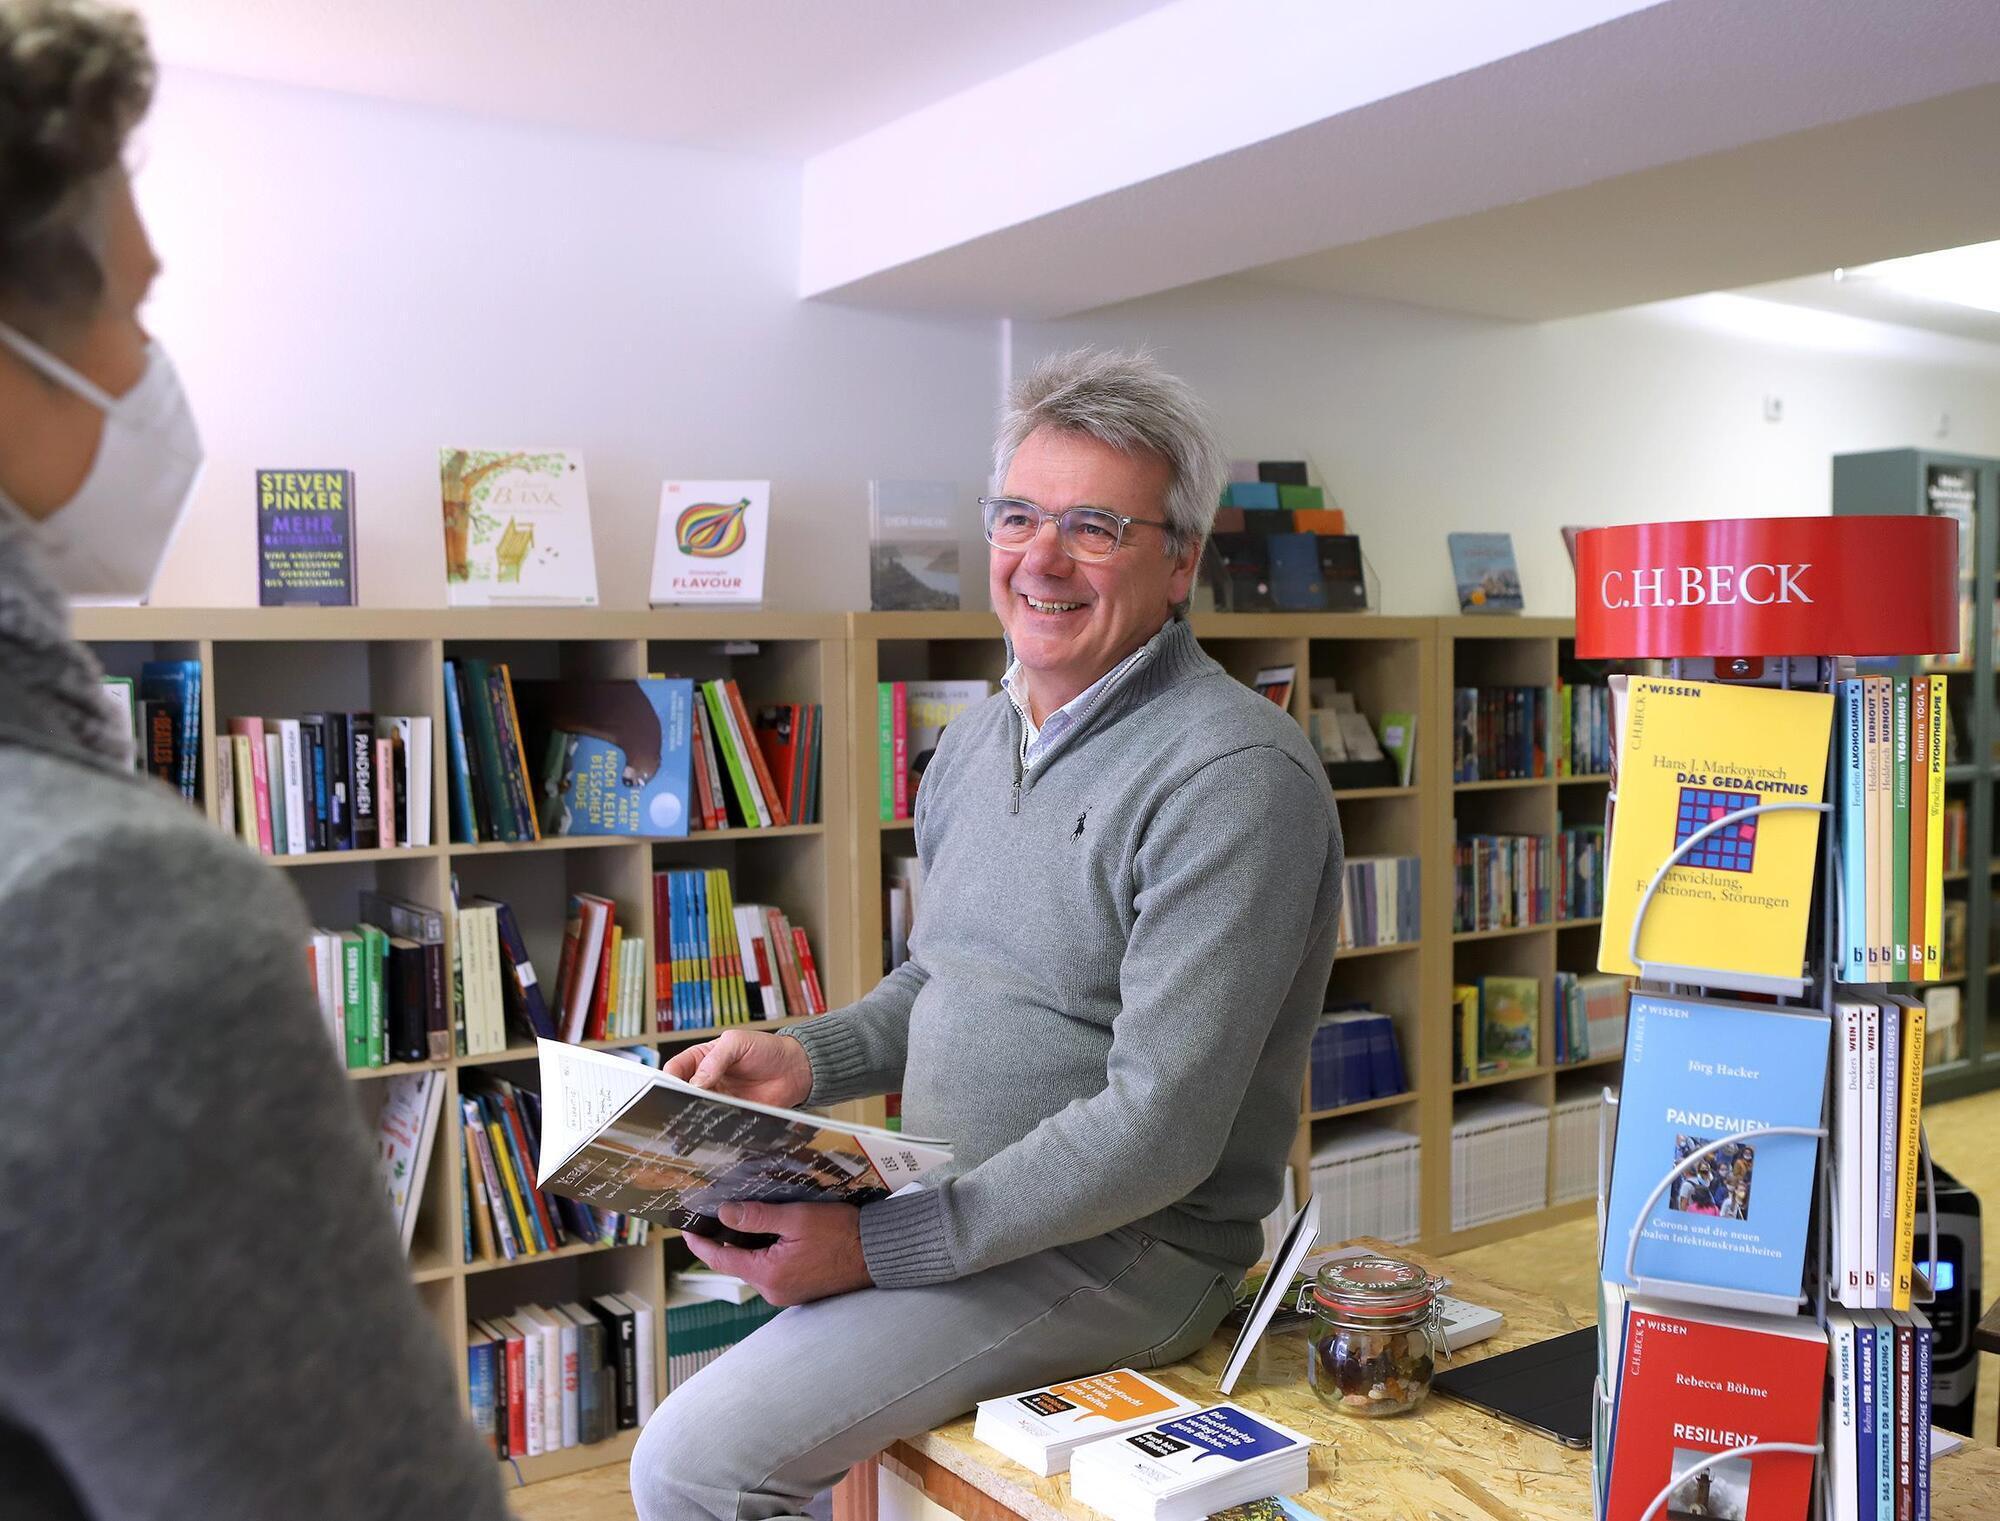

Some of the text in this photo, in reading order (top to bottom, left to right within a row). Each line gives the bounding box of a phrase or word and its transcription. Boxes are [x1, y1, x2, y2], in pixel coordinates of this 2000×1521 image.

[261, 473, 343, 492] STEVEN
[262, 491, 343, 510] PINKER
[272, 516, 333, 533] MEHR
[672, 577, 742, 588] FLAVOUR
[1601, 563, 1815, 609] C.H.BECK
[1650, 684, 1701, 698] WISSEN
[1916, 694, 1926, 720] YOGA
[1631, 697, 1646, 750] C.H.BECK
[1852, 698, 1860, 770] ALKOHOLISMUS
[1933, 696, 1942, 773] PSYCHOTHERAPIE
[1868, 698, 1877, 792] Hedderich BURNOUT
[1882, 696, 1890, 791] Hedderich BURNOUT
[1897, 696, 1906, 808] Leitzmann VEGANISMUS
[355, 733, 371, 815] PANDEMIEN
[1652, 755, 1787, 780] Hans J. Markowitsch
[589, 754, 603, 824] BISSCHEN
[603, 749, 617, 829] NOCH KEIN
[1676, 773, 1809, 795] DAS GEDÄCHTNIS
[1656, 867, 1743, 890] ntwicklung,
[1649, 1005, 1689, 1019] WISSEN
[1633, 1014, 1646, 1063] C.H.BECK
[1688, 1060, 1760, 1080] Jörg Hacker
[1849, 1026, 1857, 1091] Deckers WEIN
[1867, 1025, 1876, 1090] Deckers WEIN
[1911, 1027, 1922, 1104] WELTGESCHICHTE
[1882, 1024, 1896, 1218] Dittmann DER SPRACHERWERB DES KINDES
[1910, 1109, 1919, 1126] DER
[1908, 1128, 1917, 1156] DATEN
[1905, 1158, 1916, 1220] WICHTIGSTEN
[1653, 1217, 1760, 1242] Corona und die neuen
[1904, 1221, 1912, 1237] DIE
[1673, 1233, 1782, 1259] Infektionskrankheiten
[1648, 1320, 1688, 1335] WISSEN
[1631, 1329, 1645, 1376] C.H.BECK
[1841, 1345, 1849, 1381] WISSEN
[1863, 1346, 1872, 1382] KORAN
[1901, 1343, 1909, 1372] REICH
[1104, 1375, 1120, 1384] Der
[1676, 1373, 1768, 1398] Rebecca Böhme
[1881, 1344, 1890, 1408] AUFKLÄRUNG
[1920, 1344, 1929, 1402] REVOLUTION
[1063, 1384, 1086, 1396] gute
[1079, 1381, 1113, 1401] hat viele
[1863, 1383, 1872, 1404] DER
[1899, 1374, 1909, 1424] RÖMISCHE
[1209, 1411, 1228, 1421] Der
[1882, 1411, 1890, 1430] DER
[1134, 1436, 1146, 1444] zu
[1142, 1433, 1179, 1452] Auch hier
[1170, 1423, 1228, 1450] gute Bücher.
[1186, 1418, 1242, 1447] verlegt viele
[1673, 1423, 1759, 1447] RESILIENZ
[1901, 1425, 1909, 1463] HEILIGE
[1919, 1403, 1929, 1471] FRANZÖSISCHE
[1882, 1434, 1890, 1479] ZEITALTER
[1901, 1464, 1909, 1485] DAS
[1919, 1471, 1928, 1488] DIE
[1882, 1482, 1890, 1501] DAS
